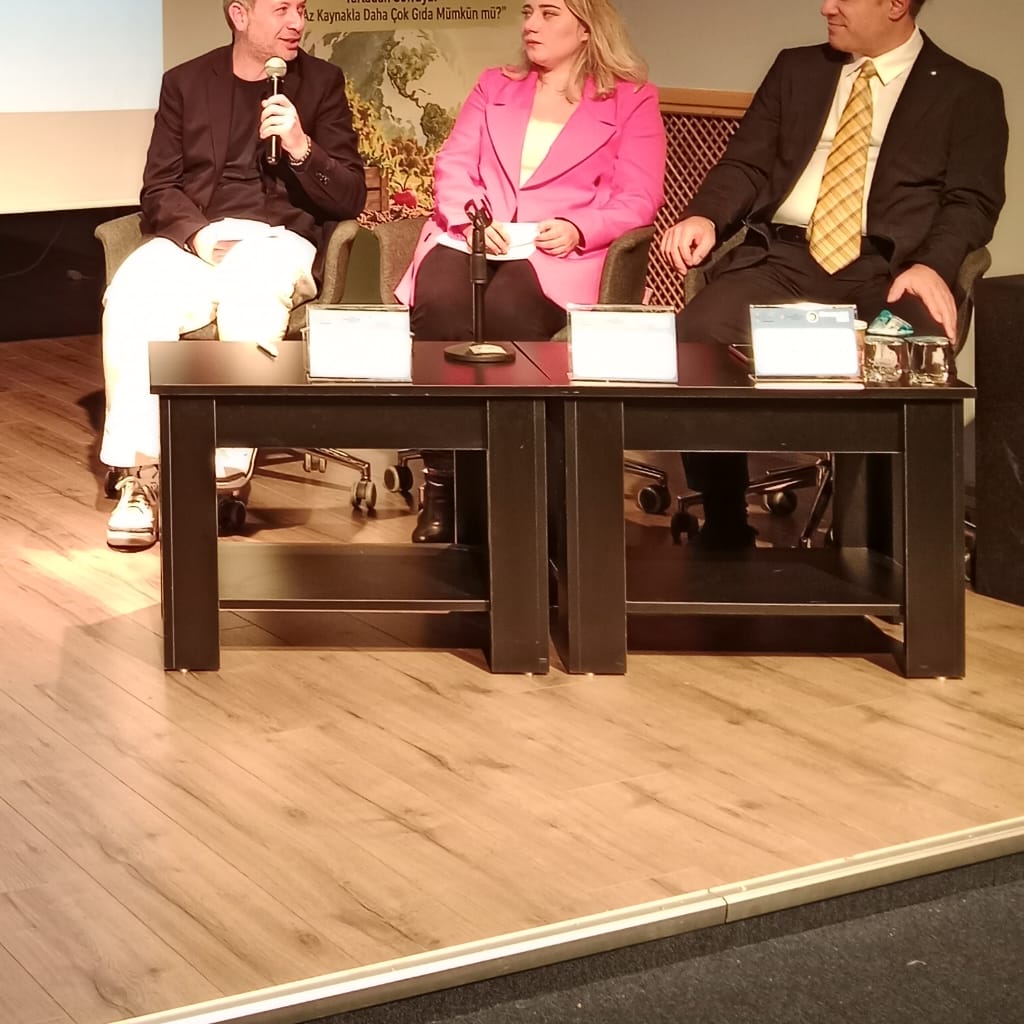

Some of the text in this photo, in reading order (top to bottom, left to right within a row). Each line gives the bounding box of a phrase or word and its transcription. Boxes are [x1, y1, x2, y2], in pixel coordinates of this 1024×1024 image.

[317, 8, 361, 24] Kaynakla
[364, 8, 388, 21] Daha
[391, 7, 409, 23] Çok
[411, 7, 433, 20] Gıda
[436, 6, 479, 20] Mümkün
